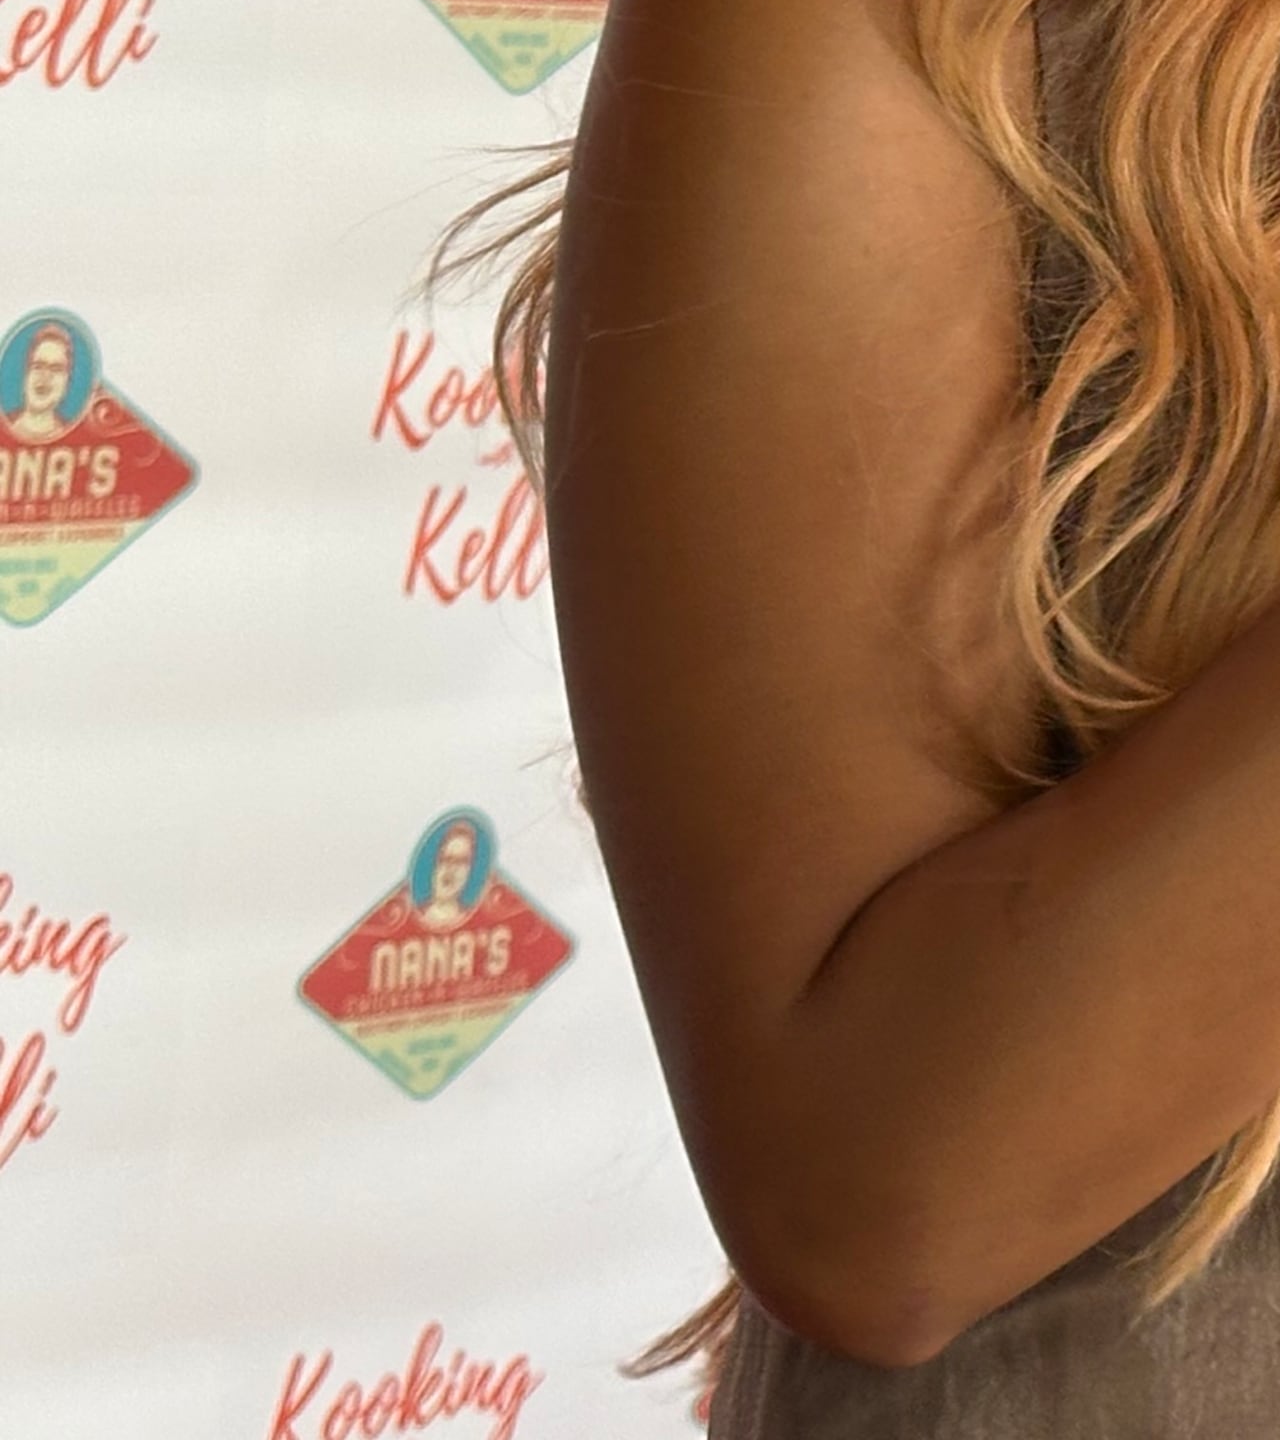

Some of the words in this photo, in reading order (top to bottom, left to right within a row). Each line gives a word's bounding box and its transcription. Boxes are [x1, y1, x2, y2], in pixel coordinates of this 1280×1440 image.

[0, 444, 121, 499] NA'S
[403, 472, 552, 605] Kell
[369, 923, 513, 993] NANA'S
[266, 1319, 546, 1440] Kooking
